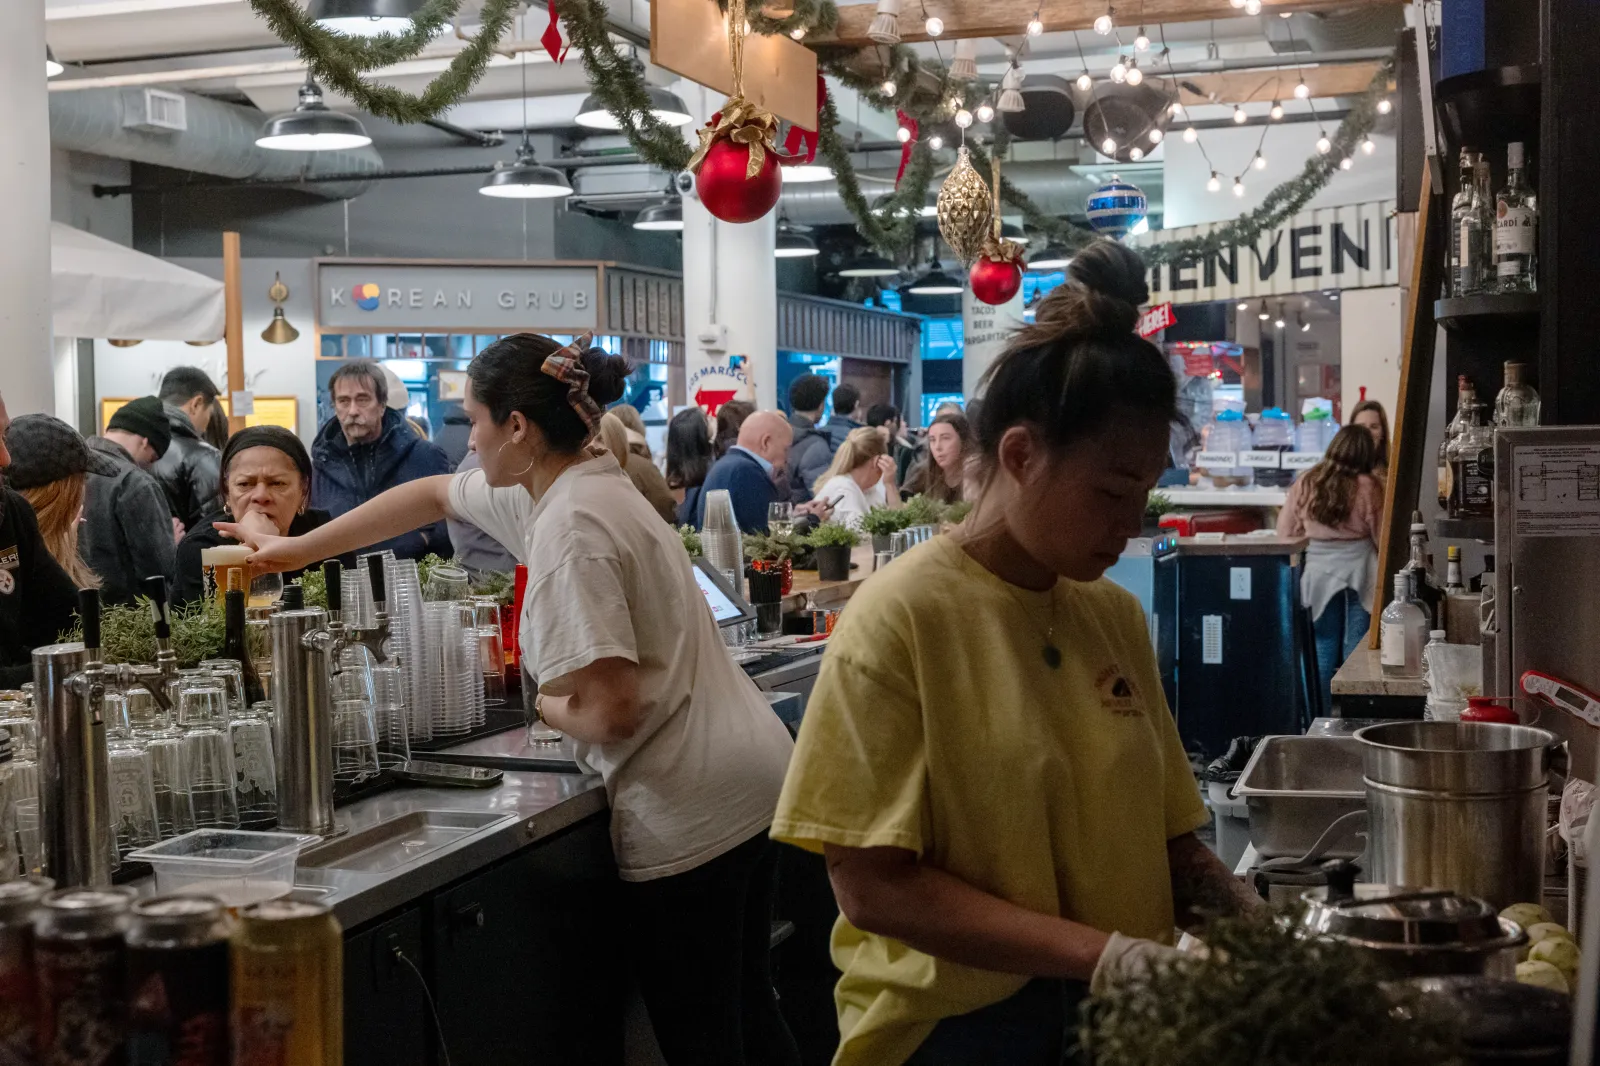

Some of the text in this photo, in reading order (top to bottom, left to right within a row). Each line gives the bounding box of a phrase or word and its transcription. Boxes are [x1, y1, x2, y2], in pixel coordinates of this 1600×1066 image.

[330, 283, 588, 311] KOREAN GRUB
[973, 320, 994, 329] BEER
